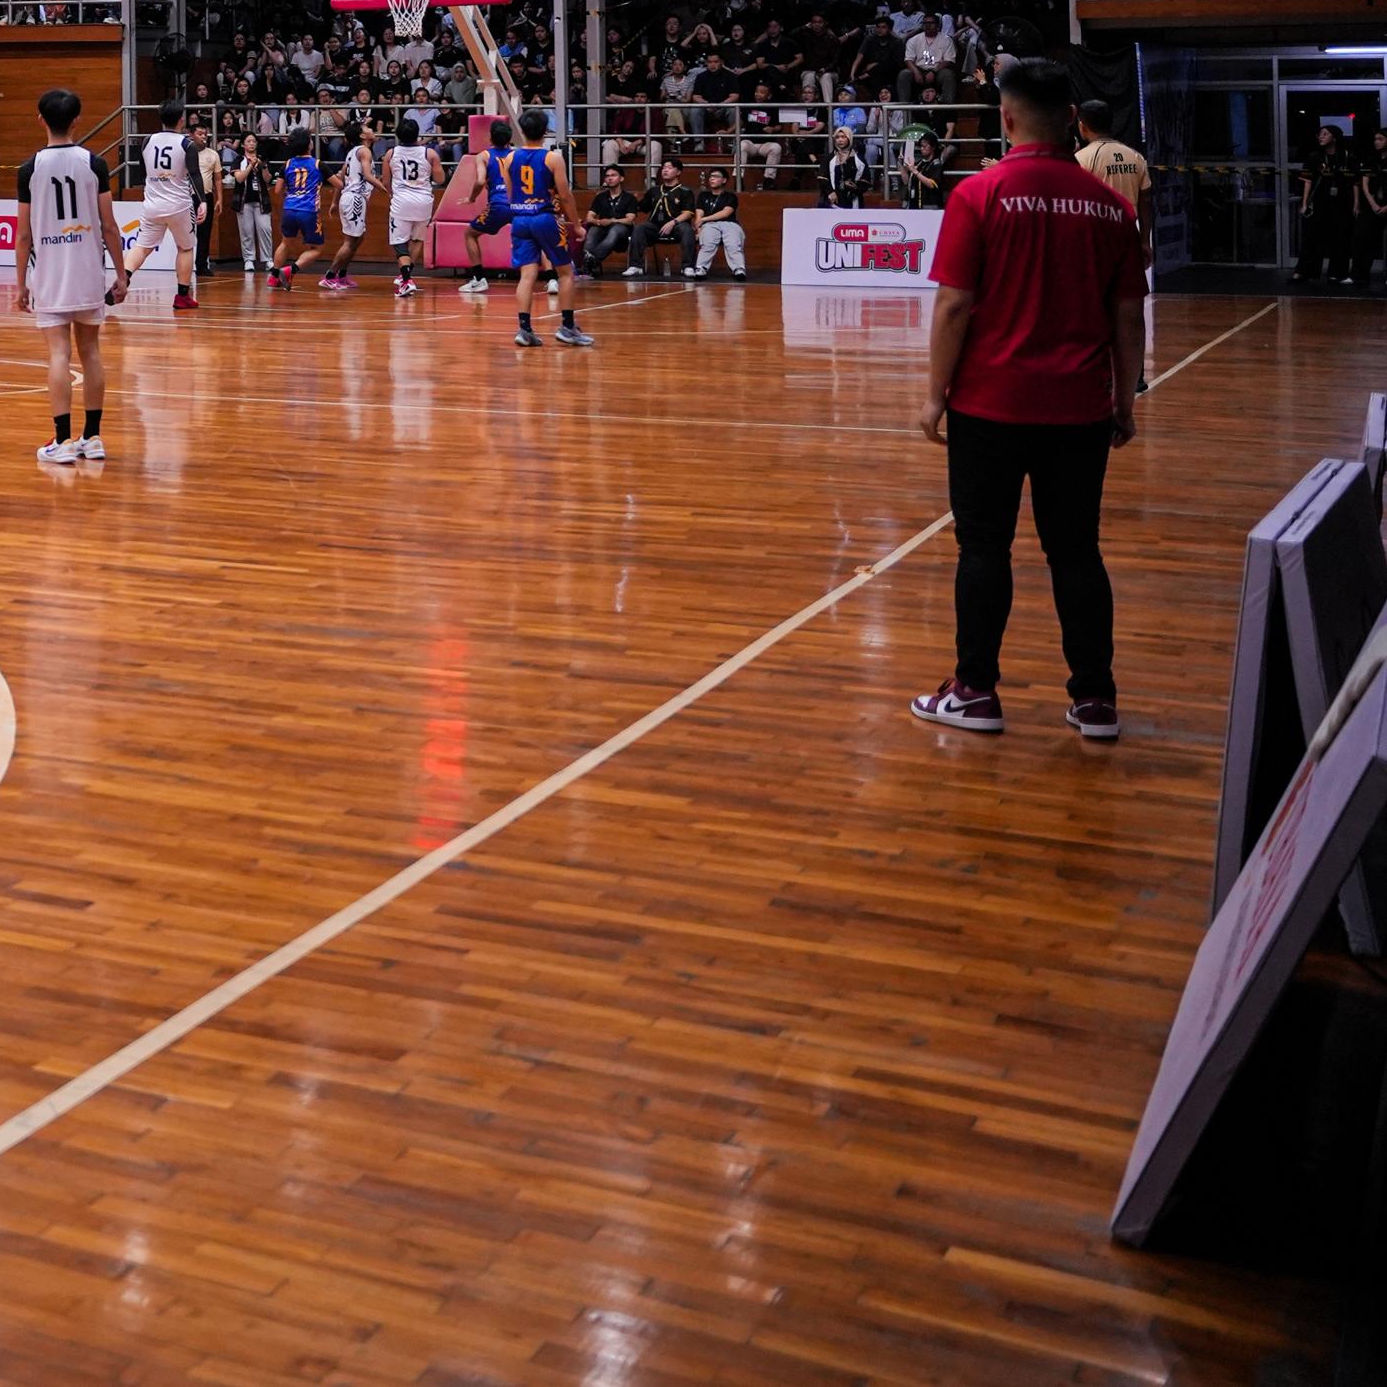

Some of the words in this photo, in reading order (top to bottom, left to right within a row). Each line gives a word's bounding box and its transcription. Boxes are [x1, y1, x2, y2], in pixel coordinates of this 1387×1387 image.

[154, 146, 174, 170] 15
[1113, 152, 1124, 162] 20
[293, 168, 309, 188] 11
[400, 159, 419, 181] 13
[520, 165, 535, 195] 9
[1106, 164, 1138, 175] REFEREE
[51, 175, 78, 221] 11
[1000, 196, 1048, 213] VIVA
[1051, 197, 1124, 224] HUKUM
[40, 232, 82, 246] mandiri
[840, 228, 865, 238] LIMA
[817, 239, 925, 273] UNIFEST
